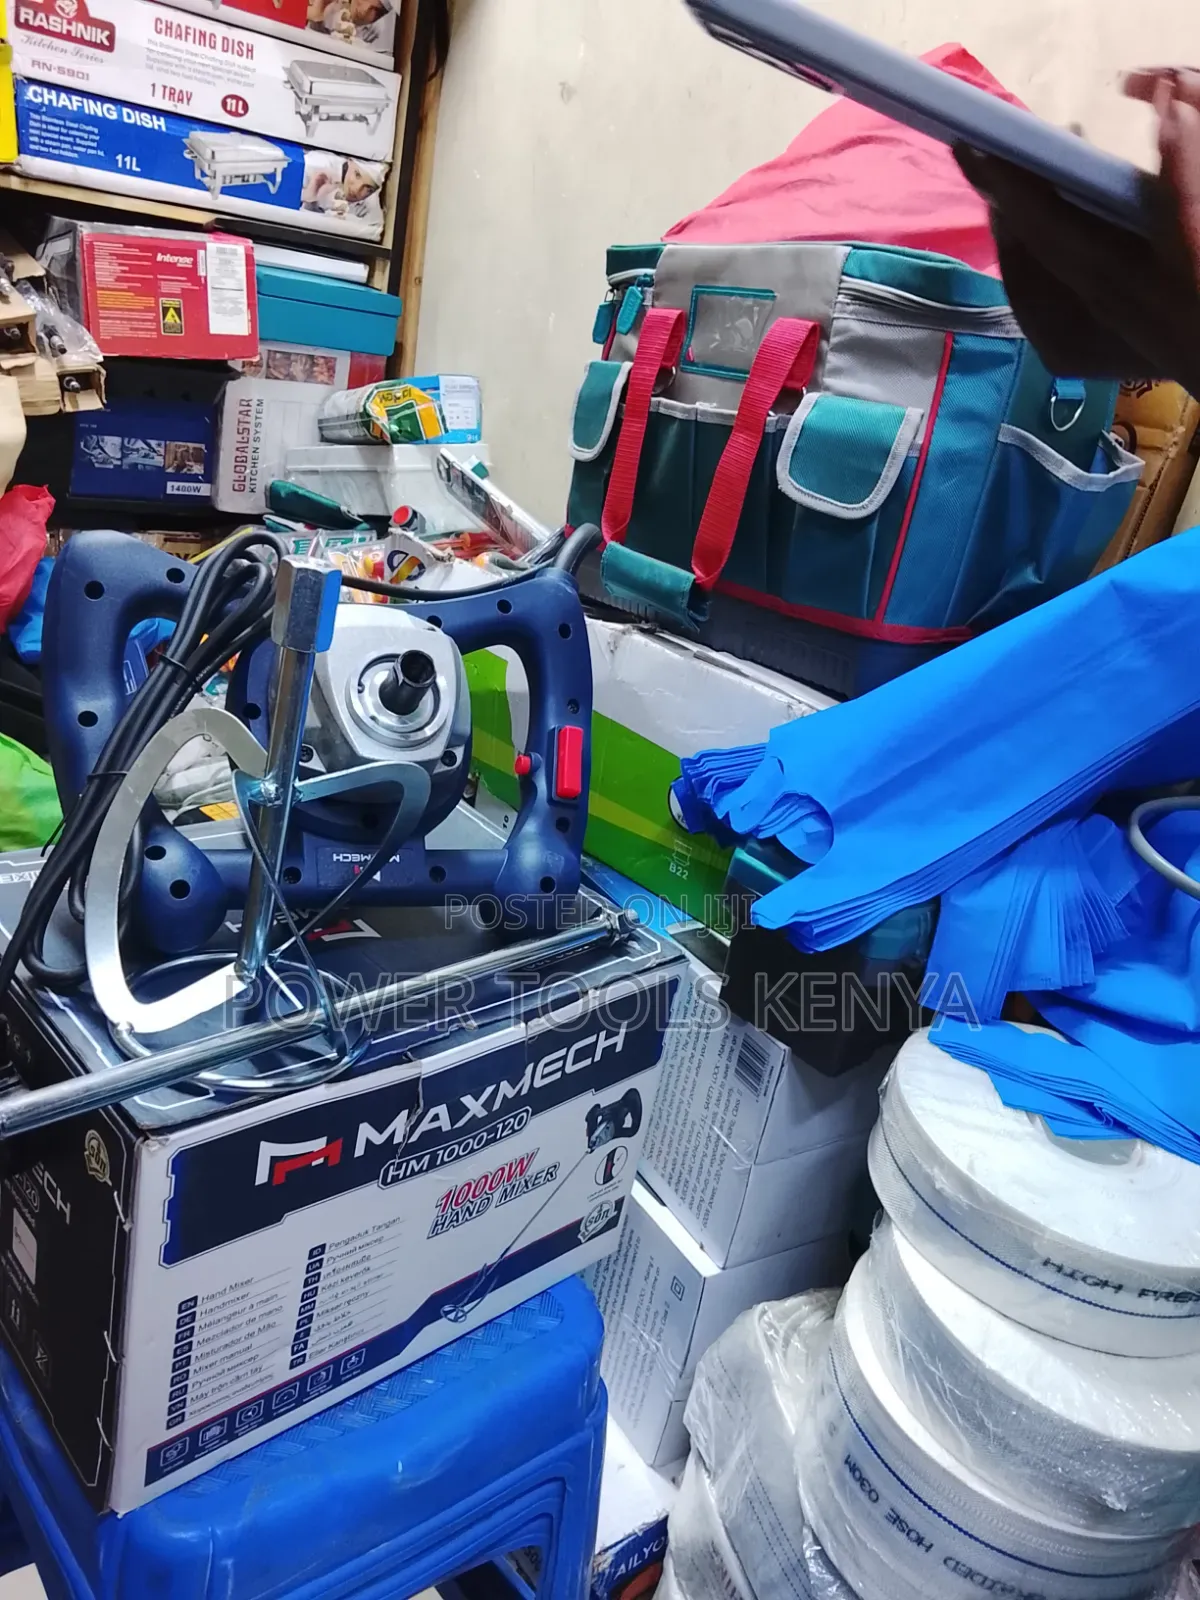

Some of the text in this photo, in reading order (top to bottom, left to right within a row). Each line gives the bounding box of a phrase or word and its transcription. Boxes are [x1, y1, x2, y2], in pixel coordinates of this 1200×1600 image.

[20, 7, 110, 46] RASHNIK
[154, 17, 254, 61] CHAFING DISH
[28, 86, 166, 132] CHAFING DISH
[151, 82, 193, 106] 1 TRAY
[226, 98, 245, 113] 11L
[116, 154, 141, 172] 11L
[248, 398, 264, 494] KITCHEN SYSTEM
[669, 862, 689, 880] B22
[353, 1025, 628, 1157] MAXMECH
[386, 1111, 528, 1183] HM 1000-120
[436, 1149, 538, 1213] 1000W
[428, 1196, 493, 1238] HAND
[496, 1163, 559, 1207] MIXER
[201, 1277, 254, 1304] Hand Mixer
[1042, 1257, 1124, 1294] HIGH
[179, 1314, 193, 1325] DE
[181, 1299, 195, 1311] EN
[200, 1292, 250, 1317] Handmixer
[193, 1343, 253, 1376] Mixer manual
[884, 1507, 934, 1553] HOSE
